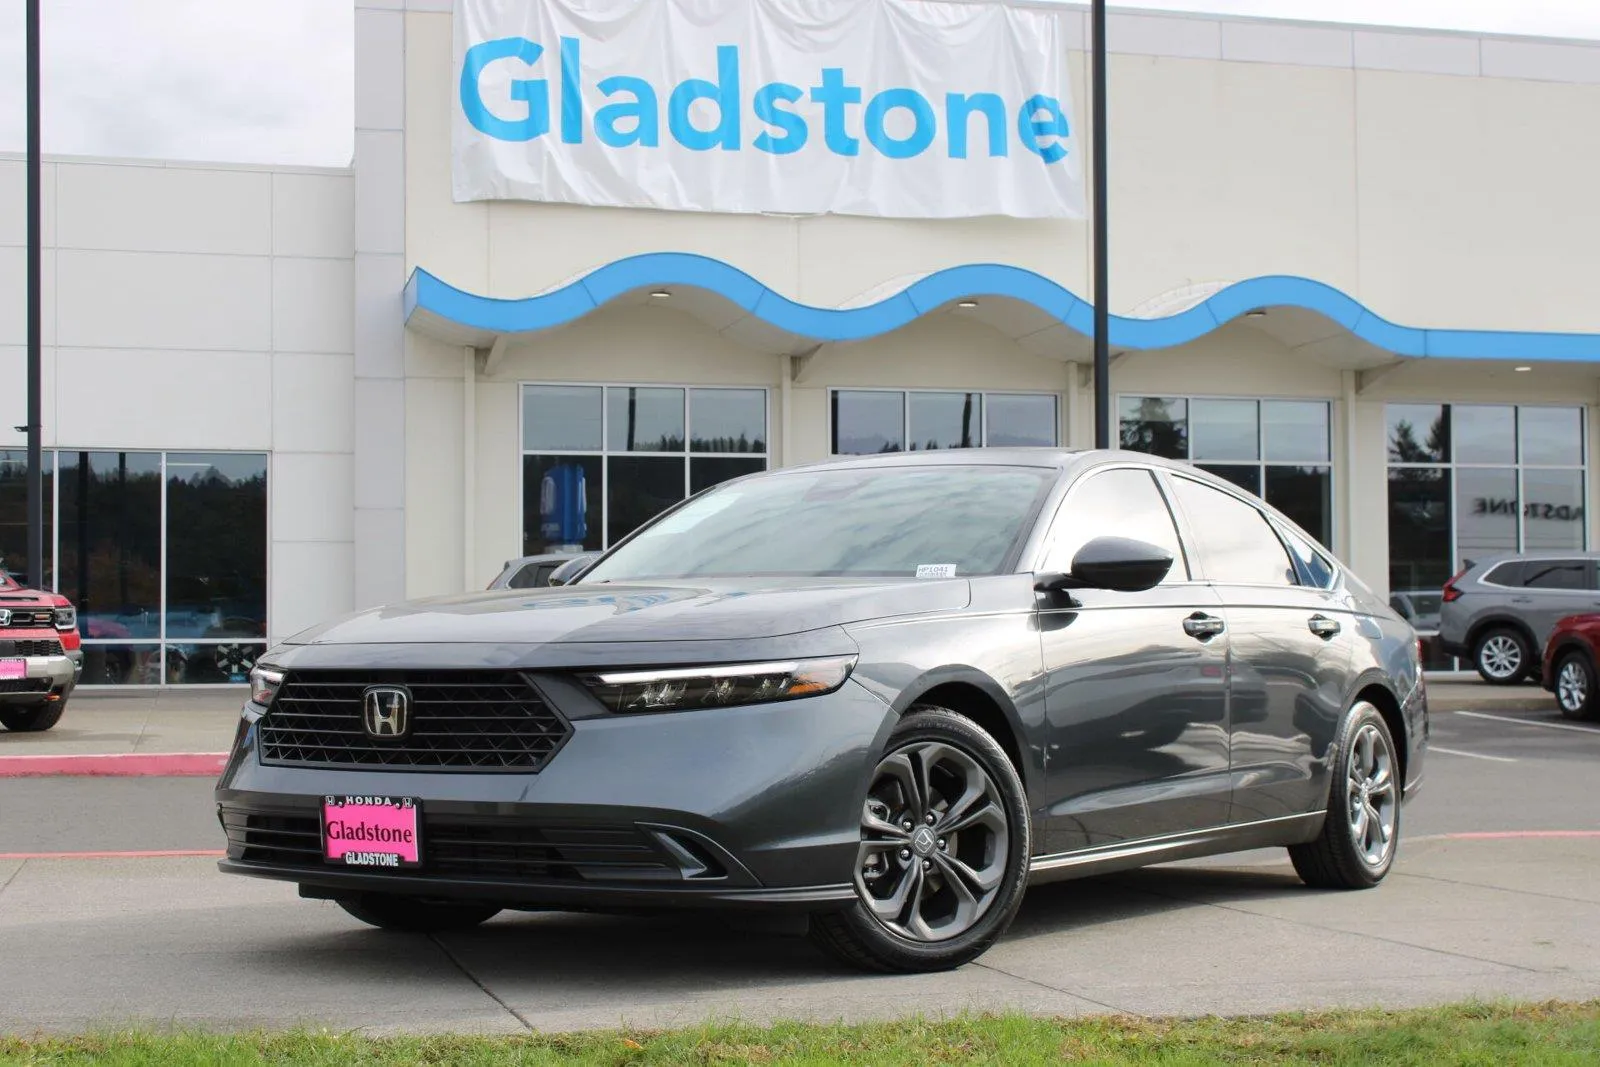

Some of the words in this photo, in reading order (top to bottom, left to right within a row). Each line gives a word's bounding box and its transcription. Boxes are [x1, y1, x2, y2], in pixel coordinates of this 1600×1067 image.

[460, 36, 1070, 165] Gladstone
[345, 796, 392, 806] HONDA
[327, 820, 412, 843] Gladstone
[345, 852, 399, 867] GLADSTONE
